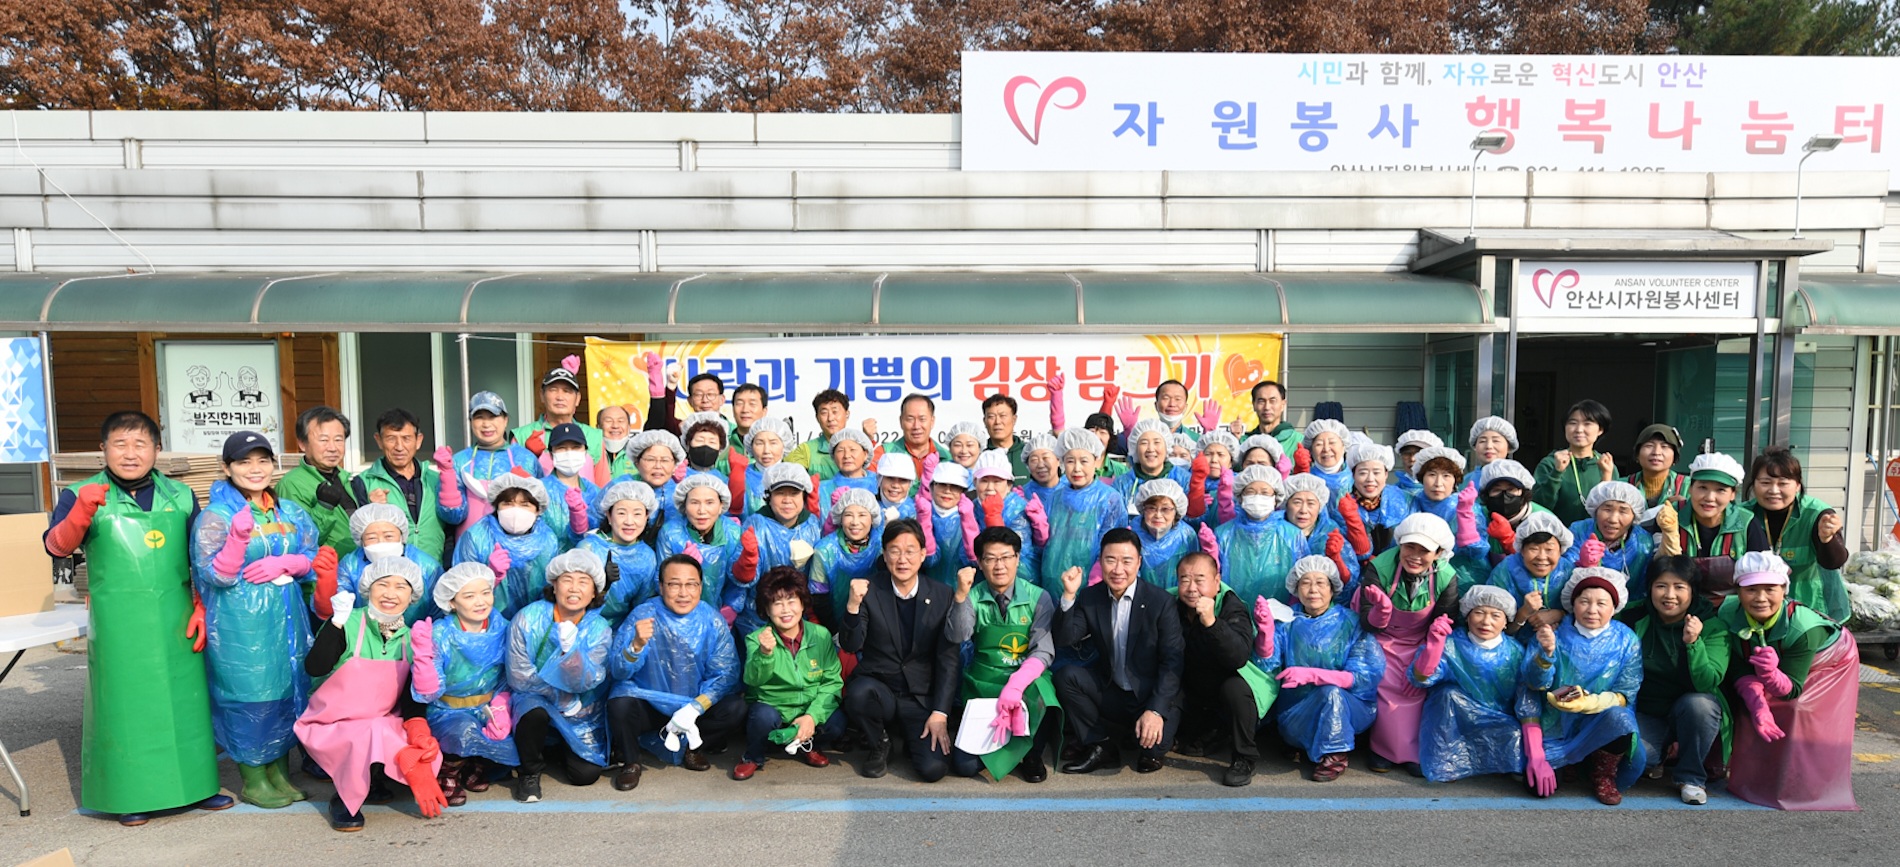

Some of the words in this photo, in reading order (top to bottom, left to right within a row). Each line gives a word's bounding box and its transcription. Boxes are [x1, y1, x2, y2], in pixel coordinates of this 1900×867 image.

[1297, 61, 1369, 86] 시민과
[1380, 61, 1432, 86] 함께,
[1442, 62, 1538, 87] 자유로운
[1552, 62, 1644, 88] 혁신도시
[1657, 62, 1707, 88] 안산
[1614, 278, 1646, 287] ANSAN
[1649, 278, 1701, 287] VOLUNTEER
[1704, 278, 1739, 287] CENTER
[1566, 290, 1739, 310] 안산시자원봉사센터
[814, 356, 952, 403] 기쁨의
[968, 356, 1062, 402] 김장
[1075, 354, 1212, 402] 담그기
[193, 411, 262, 426] 발직한카페
